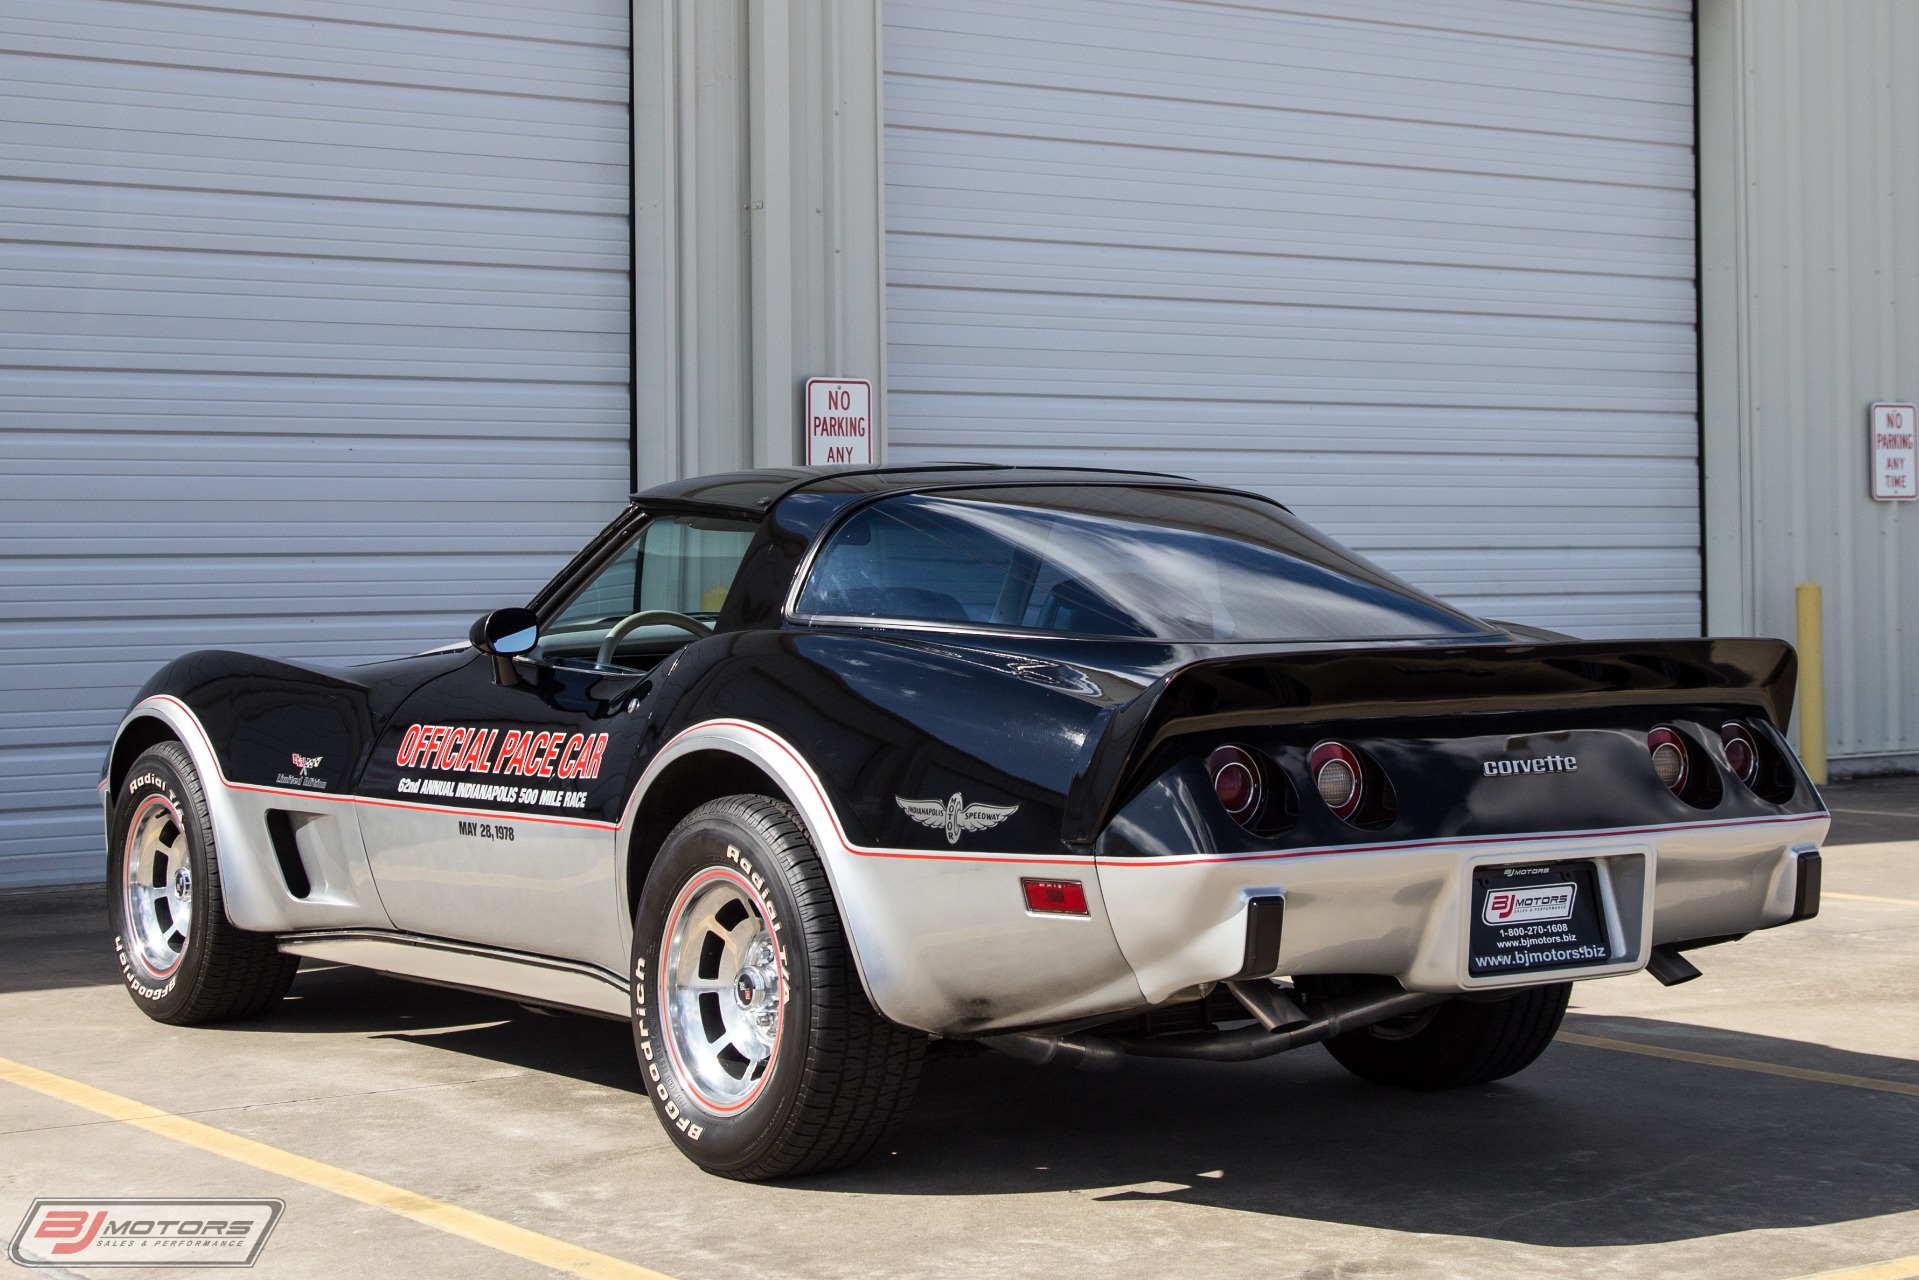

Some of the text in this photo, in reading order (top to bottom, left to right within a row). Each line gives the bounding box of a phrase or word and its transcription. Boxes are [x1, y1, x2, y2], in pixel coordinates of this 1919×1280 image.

[828, 390, 851, 411] NO
[813, 416, 866, 437] PARKING
[1886, 412, 1903, 429] NO
[1877, 433, 1914, 450] PARKING
[826, 446, 854, 463] ANY
[1886, 458, 1905, 470] ANY
[1885, 475, 1907, 489] TIME
[396, 723, 609, 780] OFFICIAL PACE CAR
[1483, 755, 1578, 777] corvette
[129, 772, 185, 821] Radial T/A
[398, 778, 588, 809] 62nd ANNUAL INDIANAPOLIS 500 MILE RACE
[907, 805, 944, 817] INDIANAPOLIS
[947, 797, 957, 840] MOTOR
[964, 812, 1001, 821] SPEEDWAY
[458, 820, 478, 837] MAY
[1491, 894, 1568, 919] BJ MOTORS
[726, 844, 791, 1005] Radial T/A
[1499, 923, 1568, 938] 1-800-270-1608
[1496, 933, 1577, 949] www.bjmotors.biz
[1475, 944, 1606, 968] www.bjmotors.biz
[115, 935, 176, 1001] BFGoodrich
[635, 957, 705, 1141] BFGoodrich
